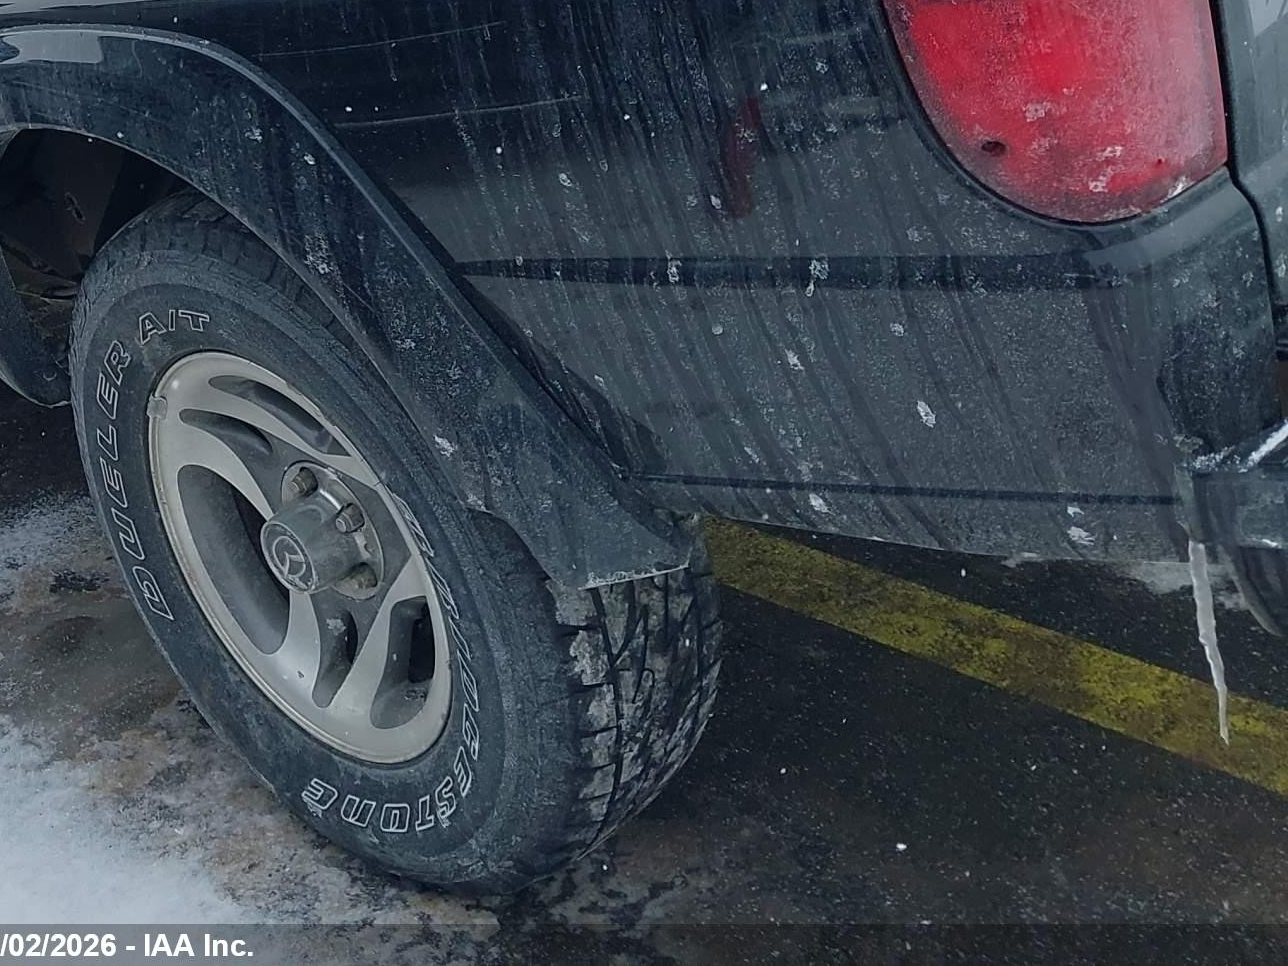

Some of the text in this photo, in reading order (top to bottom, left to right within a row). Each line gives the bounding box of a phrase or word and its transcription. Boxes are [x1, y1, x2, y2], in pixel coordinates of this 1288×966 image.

[96, 309, 210, 620] DUELER A/T
[300, 492, 479, 833] BRIDGESTONE
